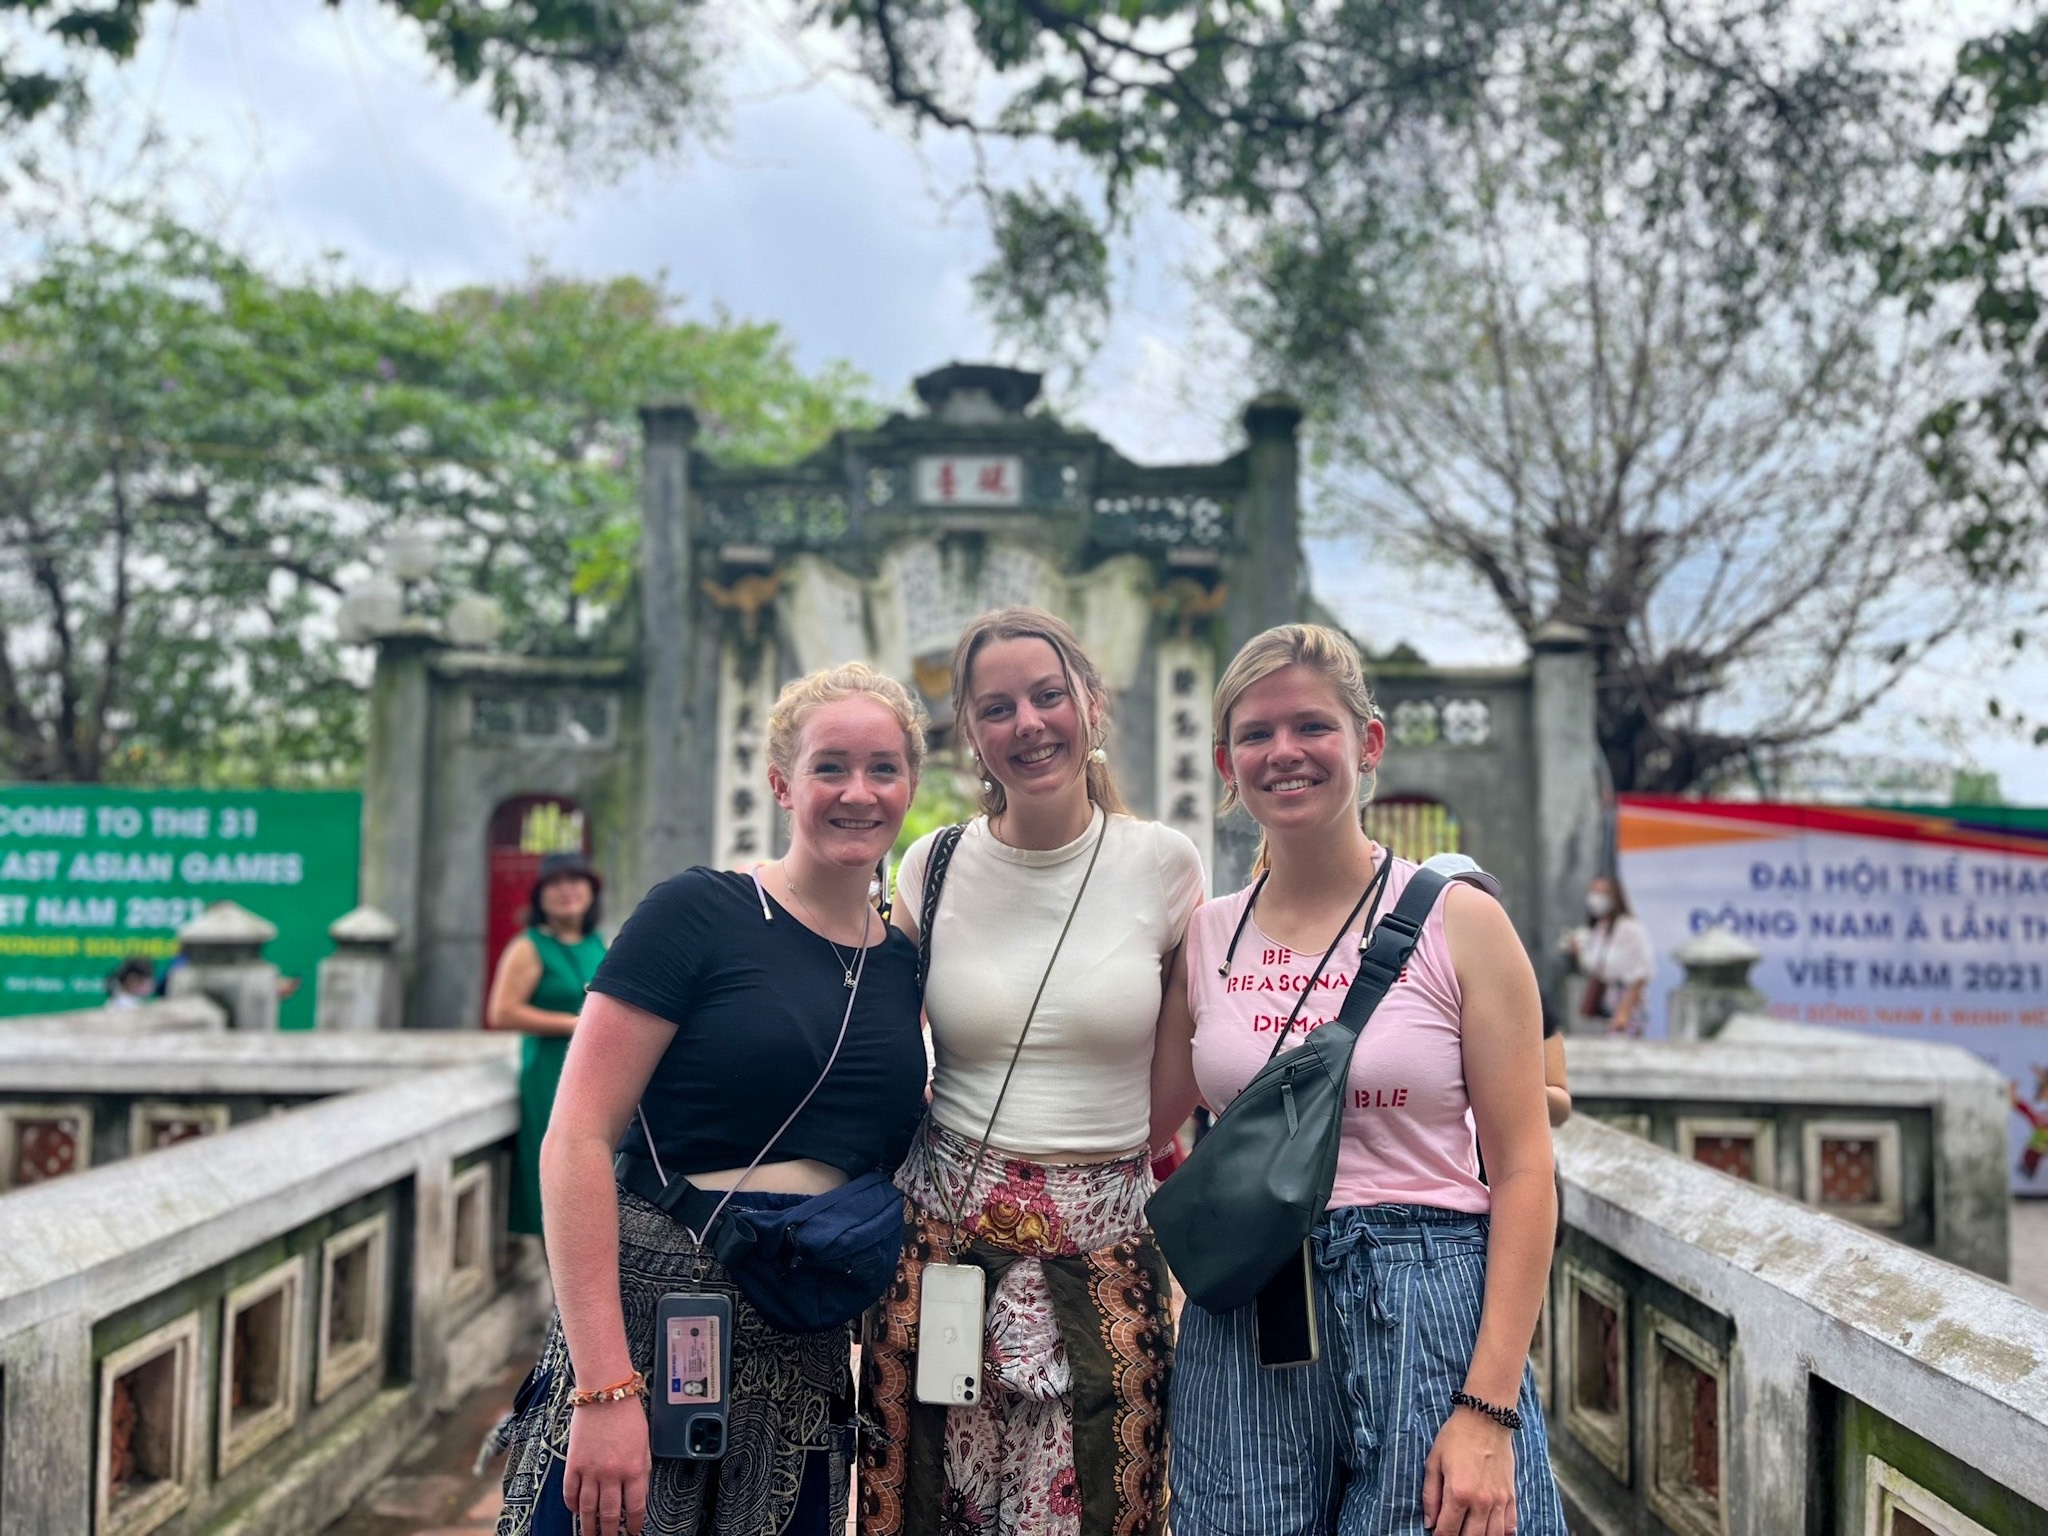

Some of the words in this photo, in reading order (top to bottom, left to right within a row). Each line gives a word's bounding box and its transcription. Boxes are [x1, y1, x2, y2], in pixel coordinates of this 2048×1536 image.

[96, 805, 142, 837] TO
[152, 807, 210, 838] THE
[219, 807, 257, 838] 31
[68, 852, 174, 883] ASIAN
[180, 852, 303, 885] GAMES
[35, 896, 116, 926] NAM
[1810, 913, 1892, 938] NAM
[1263, 949, 1291, 965] BE
[1227, 967, 1407, 993] REASONAE
[1869, 962, 1950, 988] NAM
[1964, 962, 2042, 991] 2021
